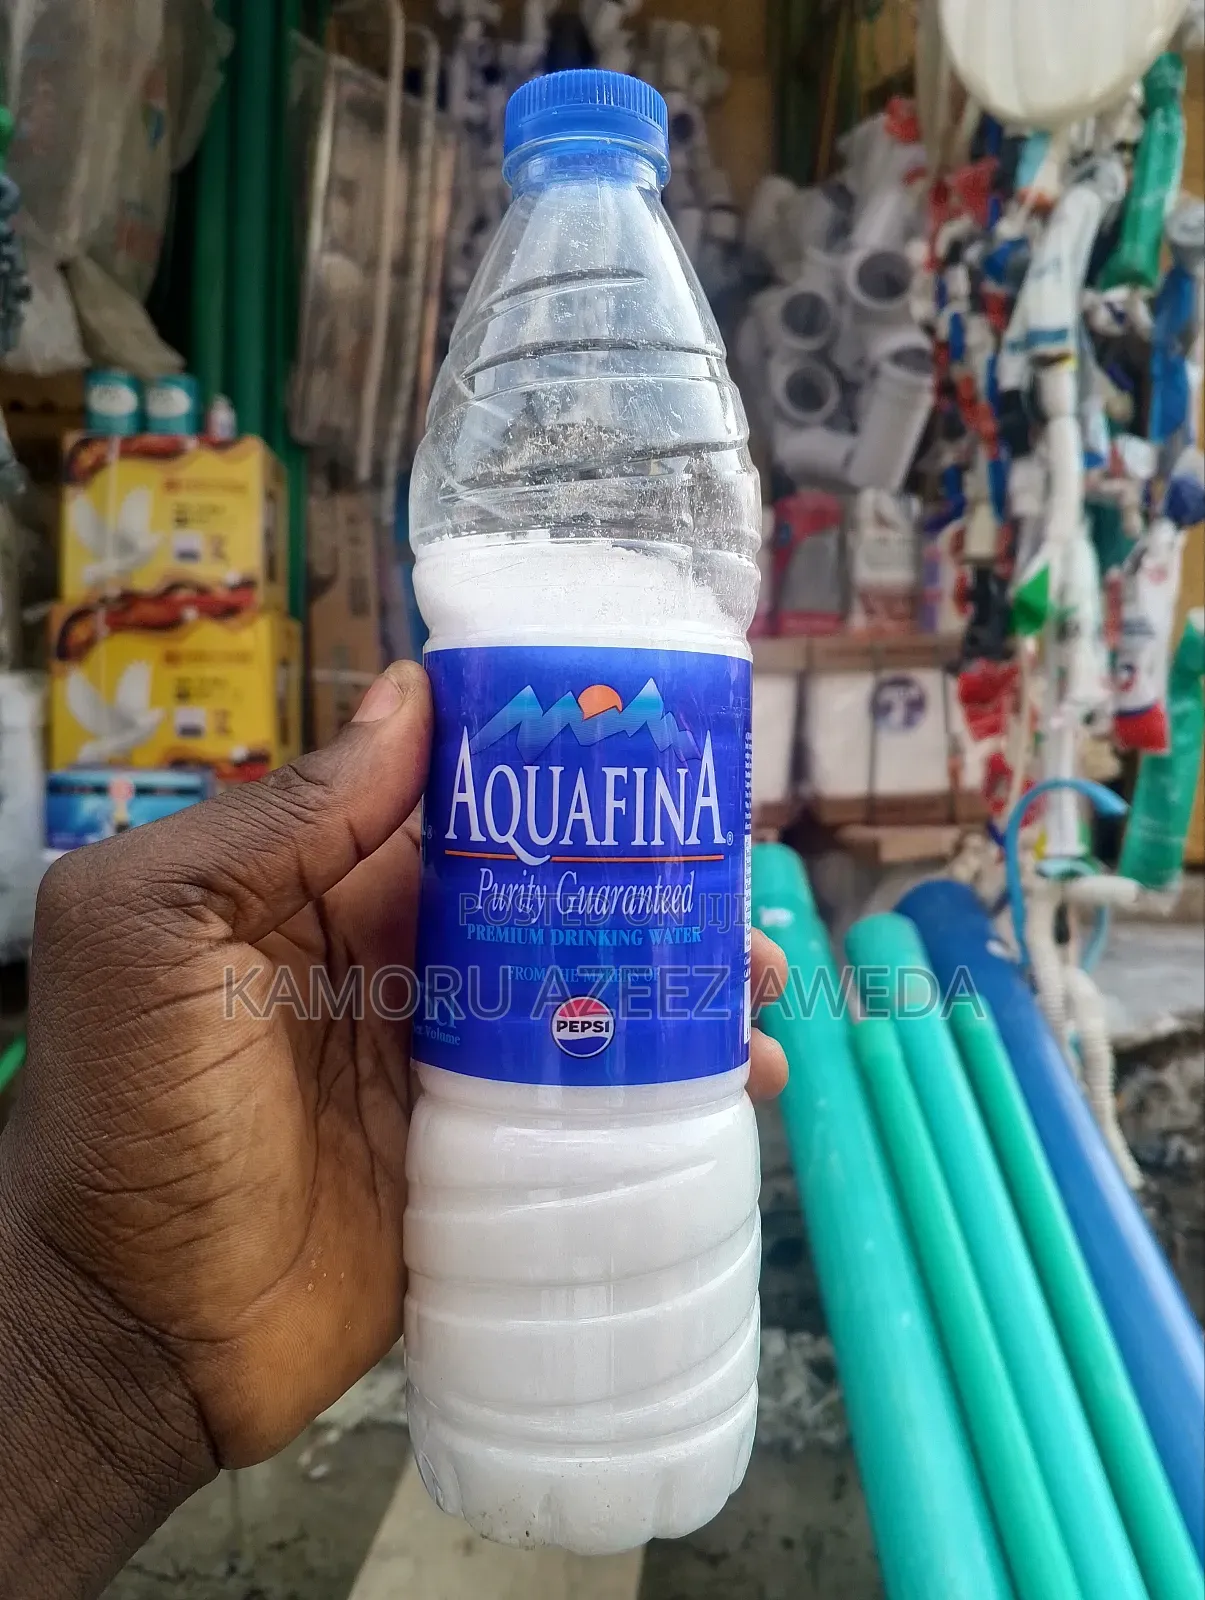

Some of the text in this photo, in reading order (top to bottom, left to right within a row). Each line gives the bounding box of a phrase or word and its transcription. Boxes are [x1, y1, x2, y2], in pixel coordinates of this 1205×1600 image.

[445, 726, 726, 865] AQUAFINA
[476, 867, 547, 924] Purity
[556, 869, 695, 916] Guaranteed
[467, 924, 702, 947] PREMIUM DRINKING WATER
[508, 965, 546, 982] FROM
[425, 1025, 461, 1046] Volume
[556, 1020, 610, 1034] PEPSI
